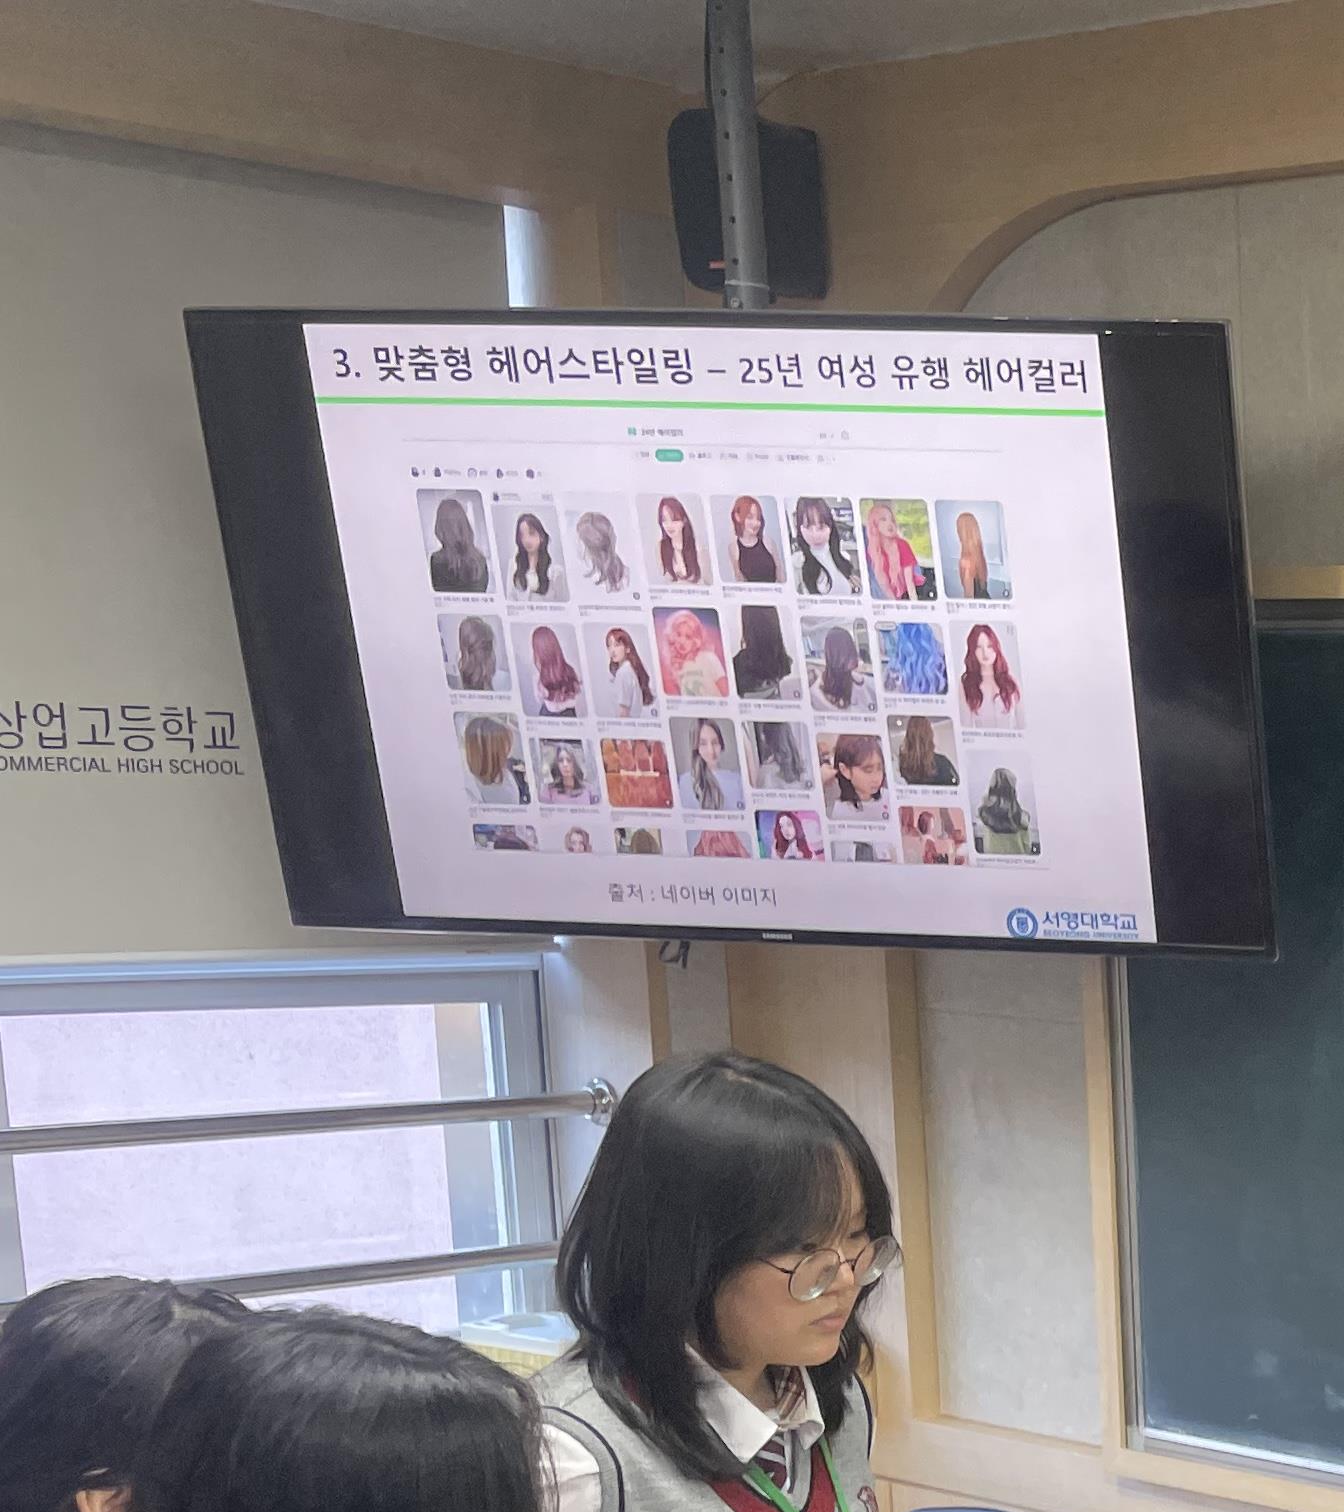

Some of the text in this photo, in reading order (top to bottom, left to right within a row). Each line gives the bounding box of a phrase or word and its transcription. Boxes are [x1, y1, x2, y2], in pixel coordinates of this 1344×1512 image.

[332, 348, 361, 379] 3.
[372, 345, 474, 383] 맞춤형
[485, 346, 694, 385] 헤어스타일링
[738, 353, 804, 388] 25년
[817, 353, 876, 389] 여성
[890, 355, 951, 391] 유행
[962, 357, 1089, 394] 헤어컬러
[117, 757, 163, 774] HIGH
[168, 758, 245, 776] SCHOOL
[608, 882, 644, 903] 출처
[660, 883, 716, 906] 네이버
[722, 886, 777, 908] 이미지
[1042, 911, 1138, 931] 서영대학교
